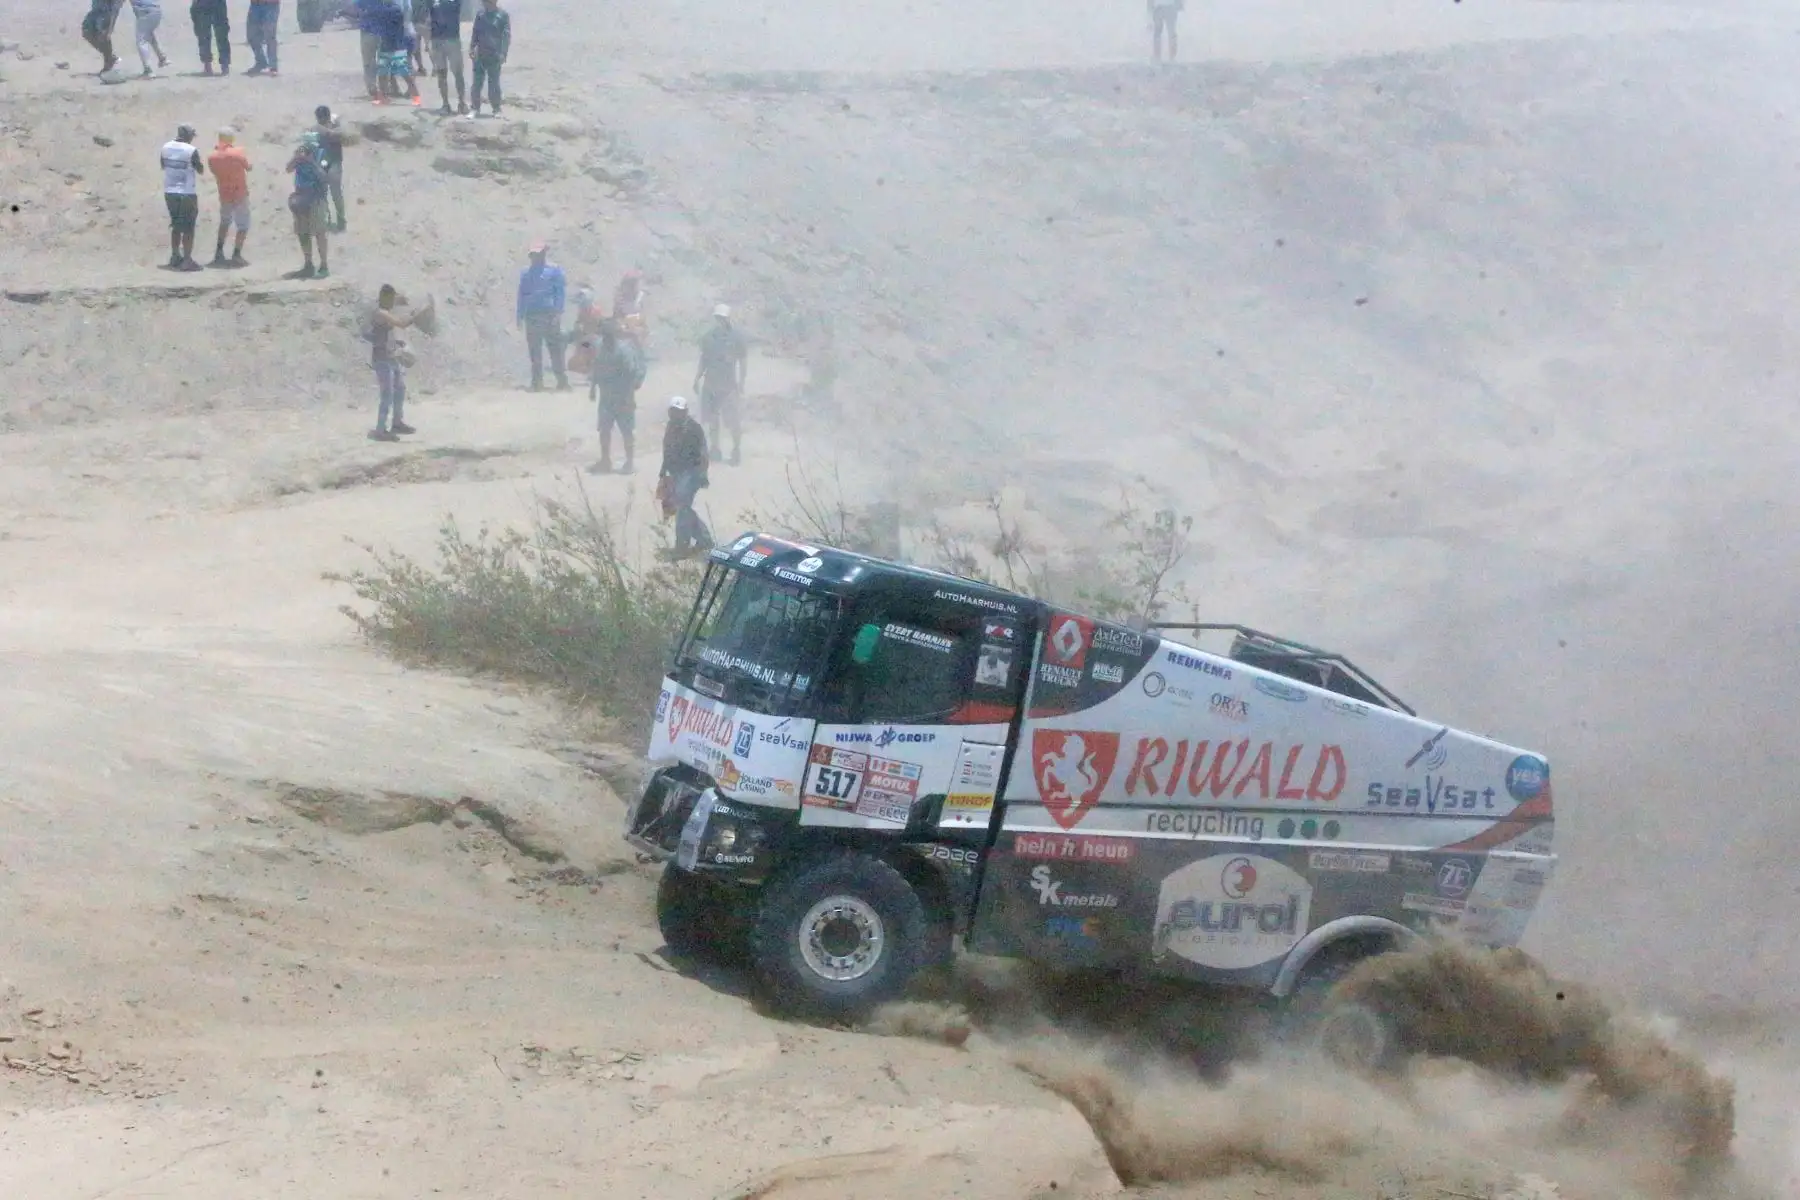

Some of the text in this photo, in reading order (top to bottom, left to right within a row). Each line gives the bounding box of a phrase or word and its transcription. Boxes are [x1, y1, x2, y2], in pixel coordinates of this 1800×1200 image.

[1094, 628, 1142, 648] AxleTech
[1167, 651, 1233, 681] REUKEMA
[835, 732, 937, 744] NIJWA GROEP
[1124, 736, 1348, 802] RIWALD
[815, 766, 858, 798] 517
[870, 775, 912, 793] MOTUL
[1146, 808, 1265, 841] recycling
[1062, 893, 1119, 908] metals
